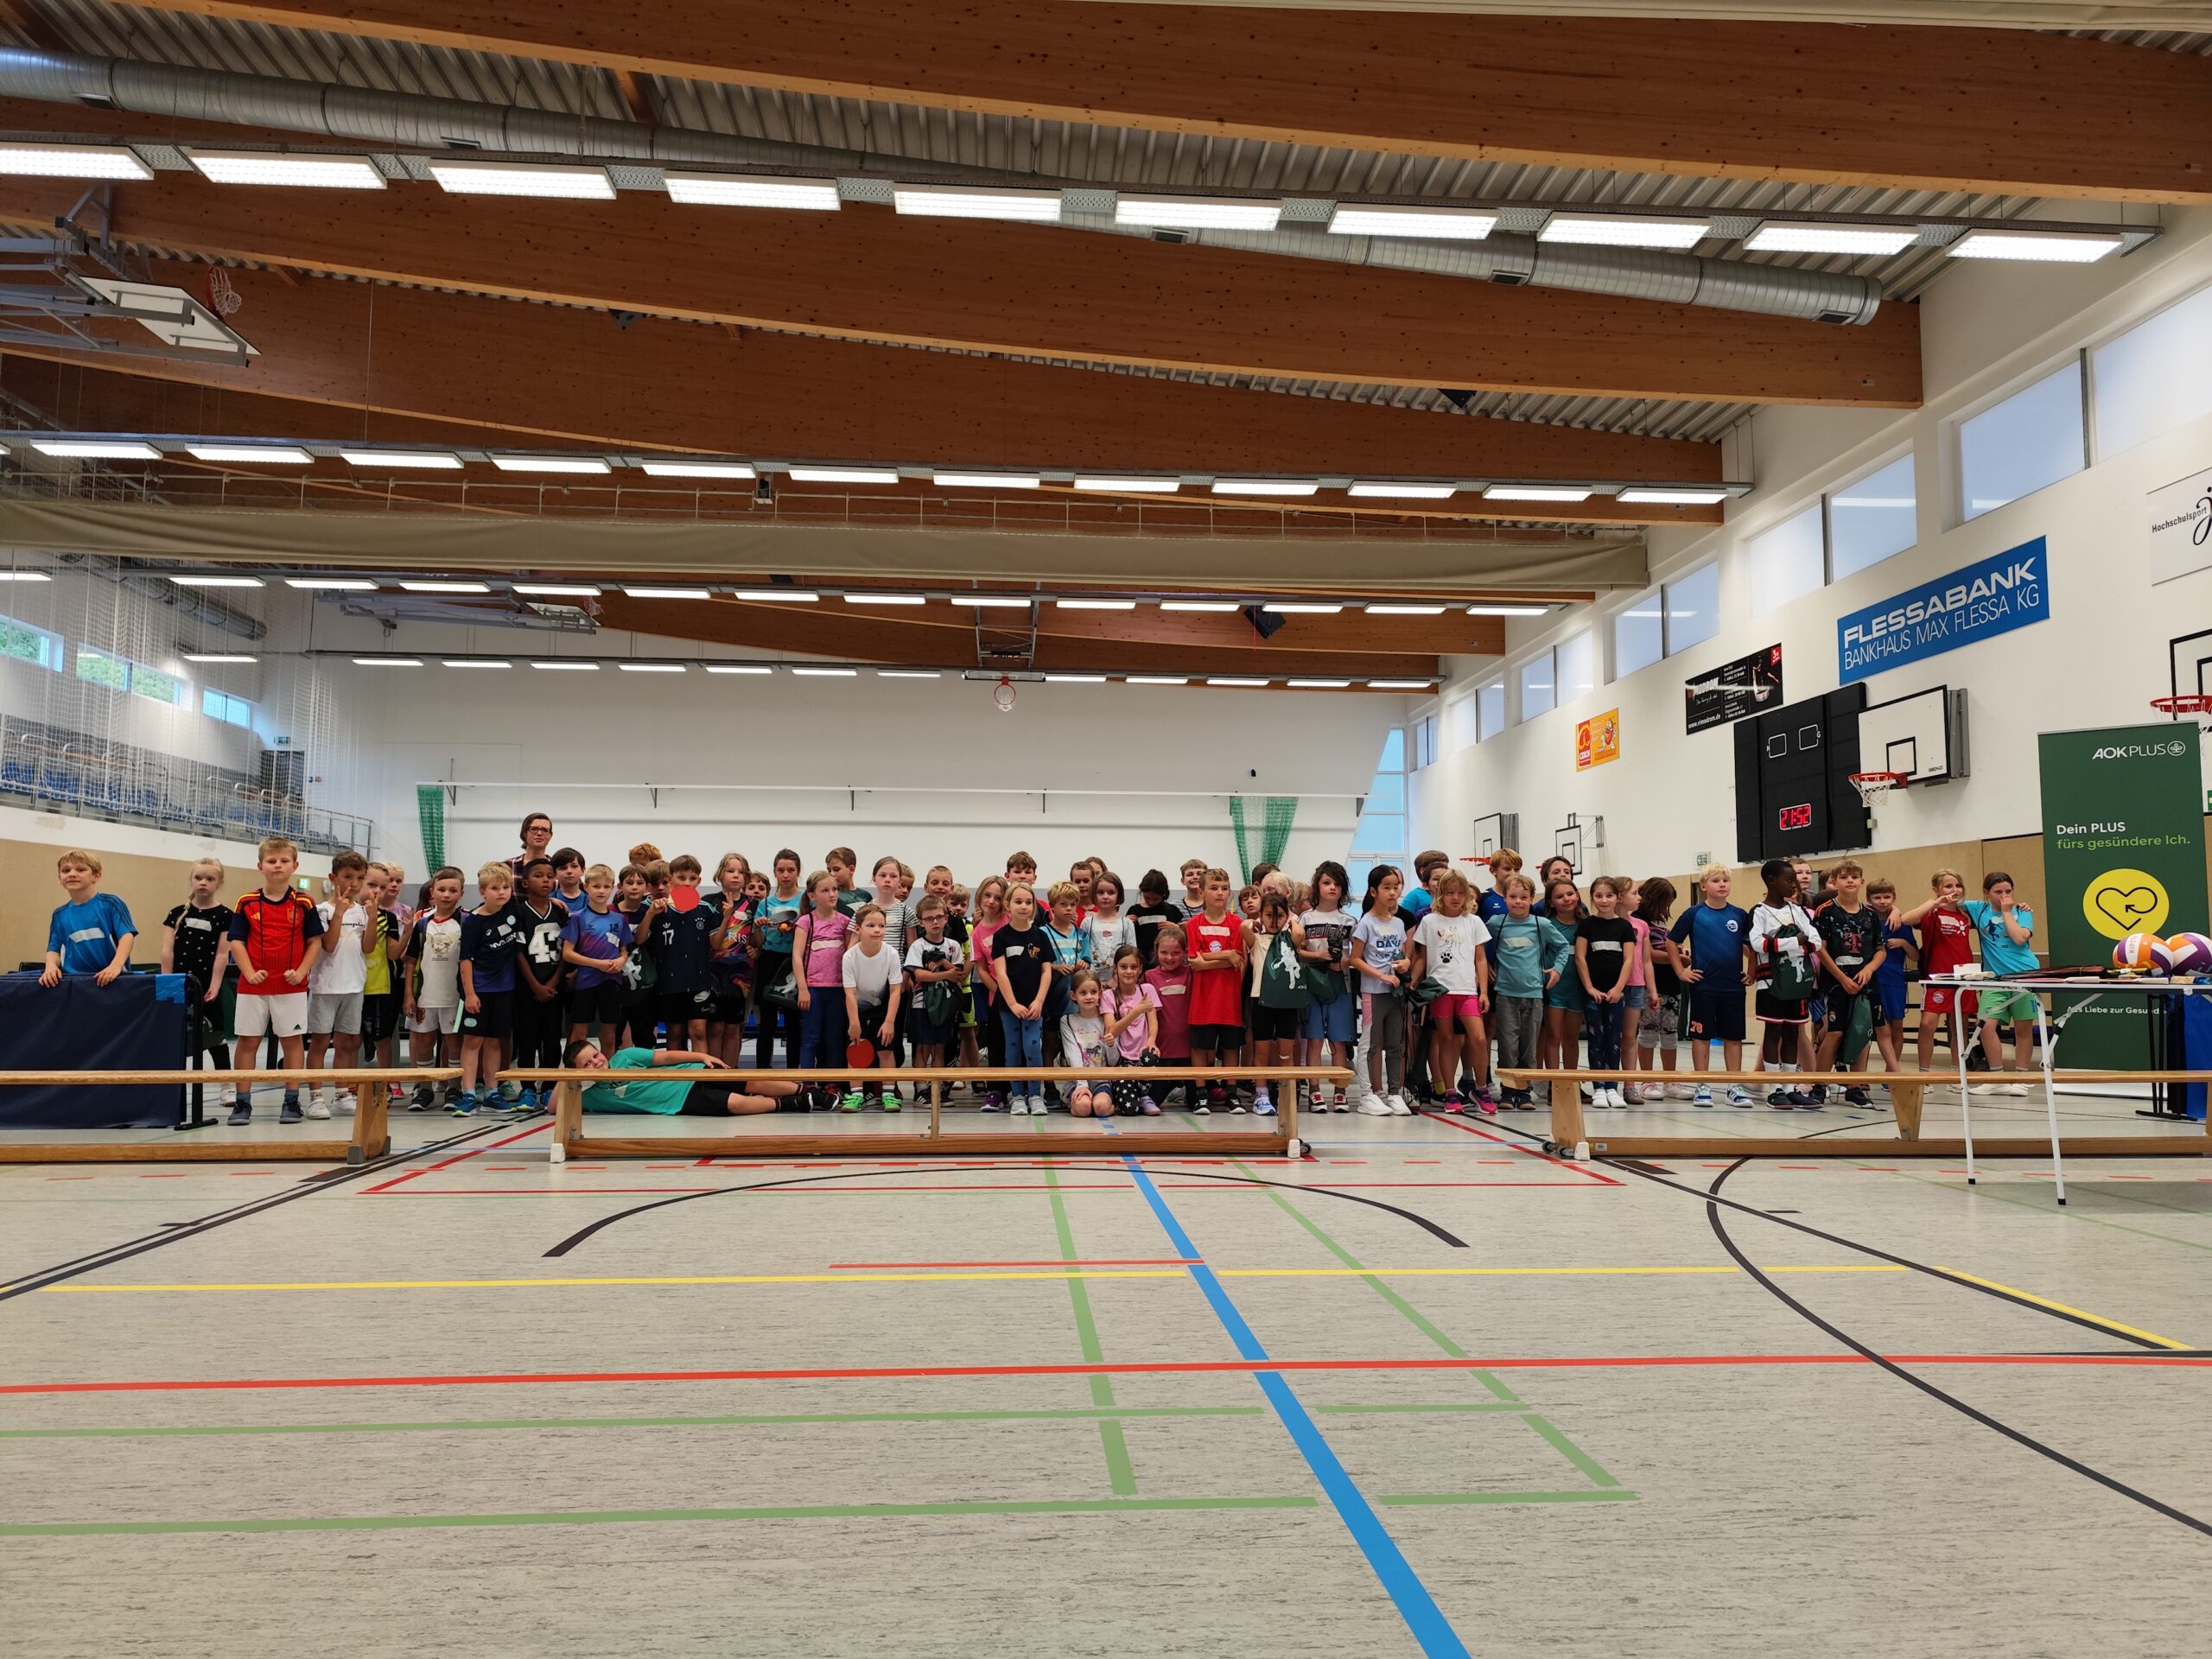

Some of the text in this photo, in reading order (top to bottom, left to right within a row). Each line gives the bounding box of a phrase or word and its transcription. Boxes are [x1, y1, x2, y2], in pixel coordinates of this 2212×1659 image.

[2152, 506, 2207, 533] Hochschulsport
[1844, 556, 2037, 649] FLESSABANK
[1845, 583, 2039, 671] BANKHAUS MAX FLESSA KG
[2056, 821, 2126, 835] Dein PLUS
[2056, 834, 2190, 850] fürs gesündere Ich.
[662, 929, 675, 946] 17
[727, 931, 747, 944] RIS
